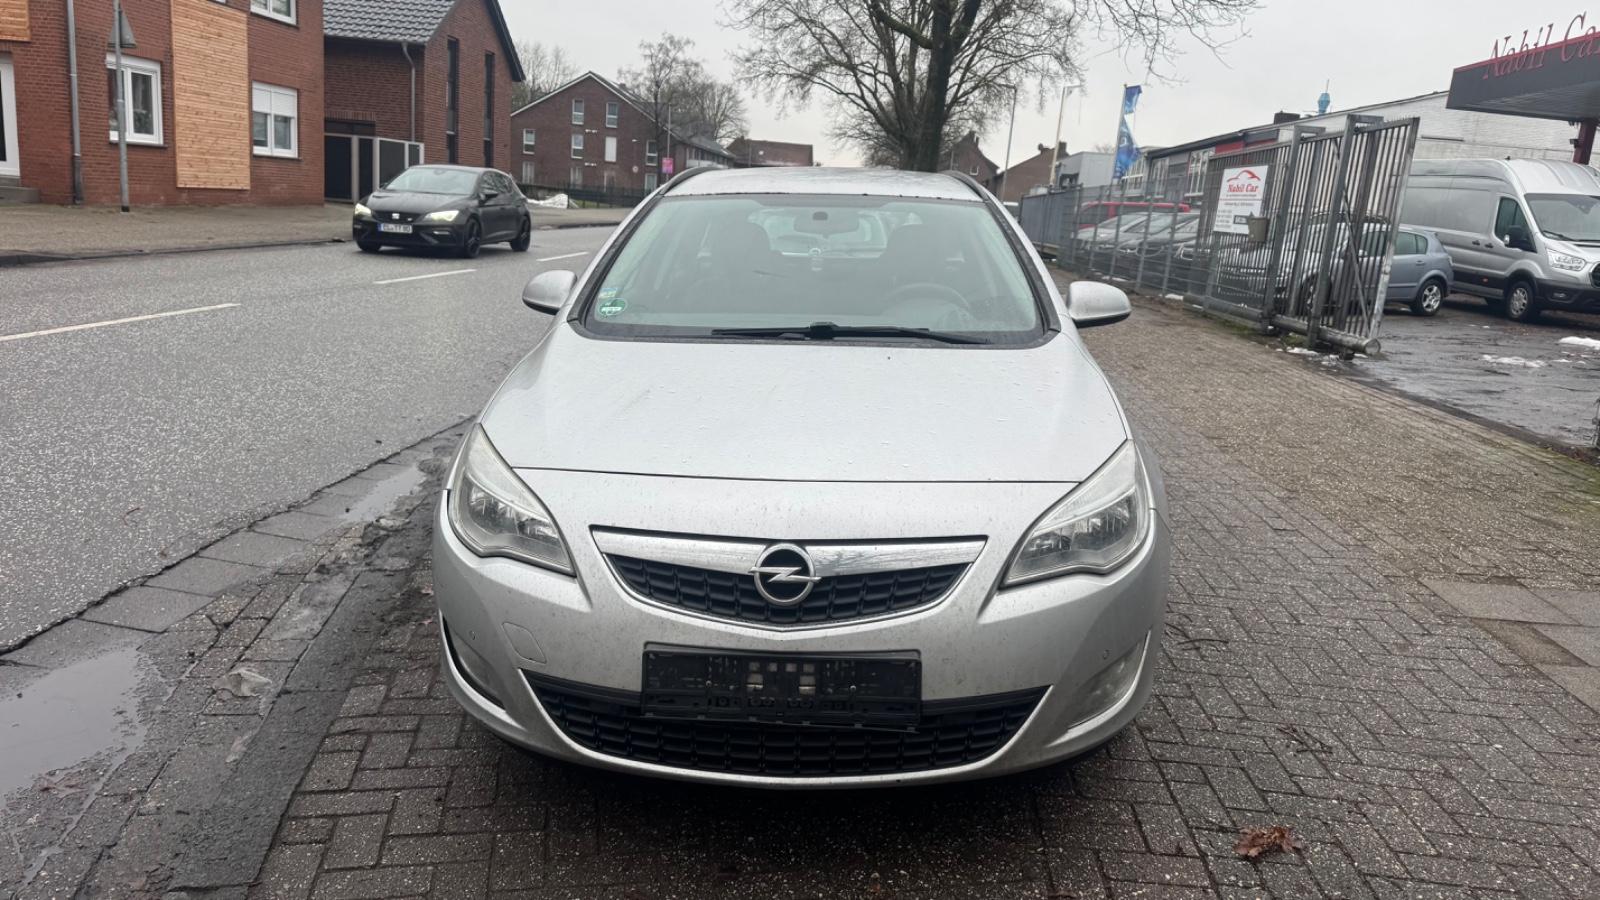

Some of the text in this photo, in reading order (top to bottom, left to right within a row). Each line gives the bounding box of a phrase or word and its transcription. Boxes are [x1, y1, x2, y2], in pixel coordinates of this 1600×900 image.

[1483, 11, 1600, 80] Nabil Ca
[1227, 183, 1259, 193] Nabil Car
